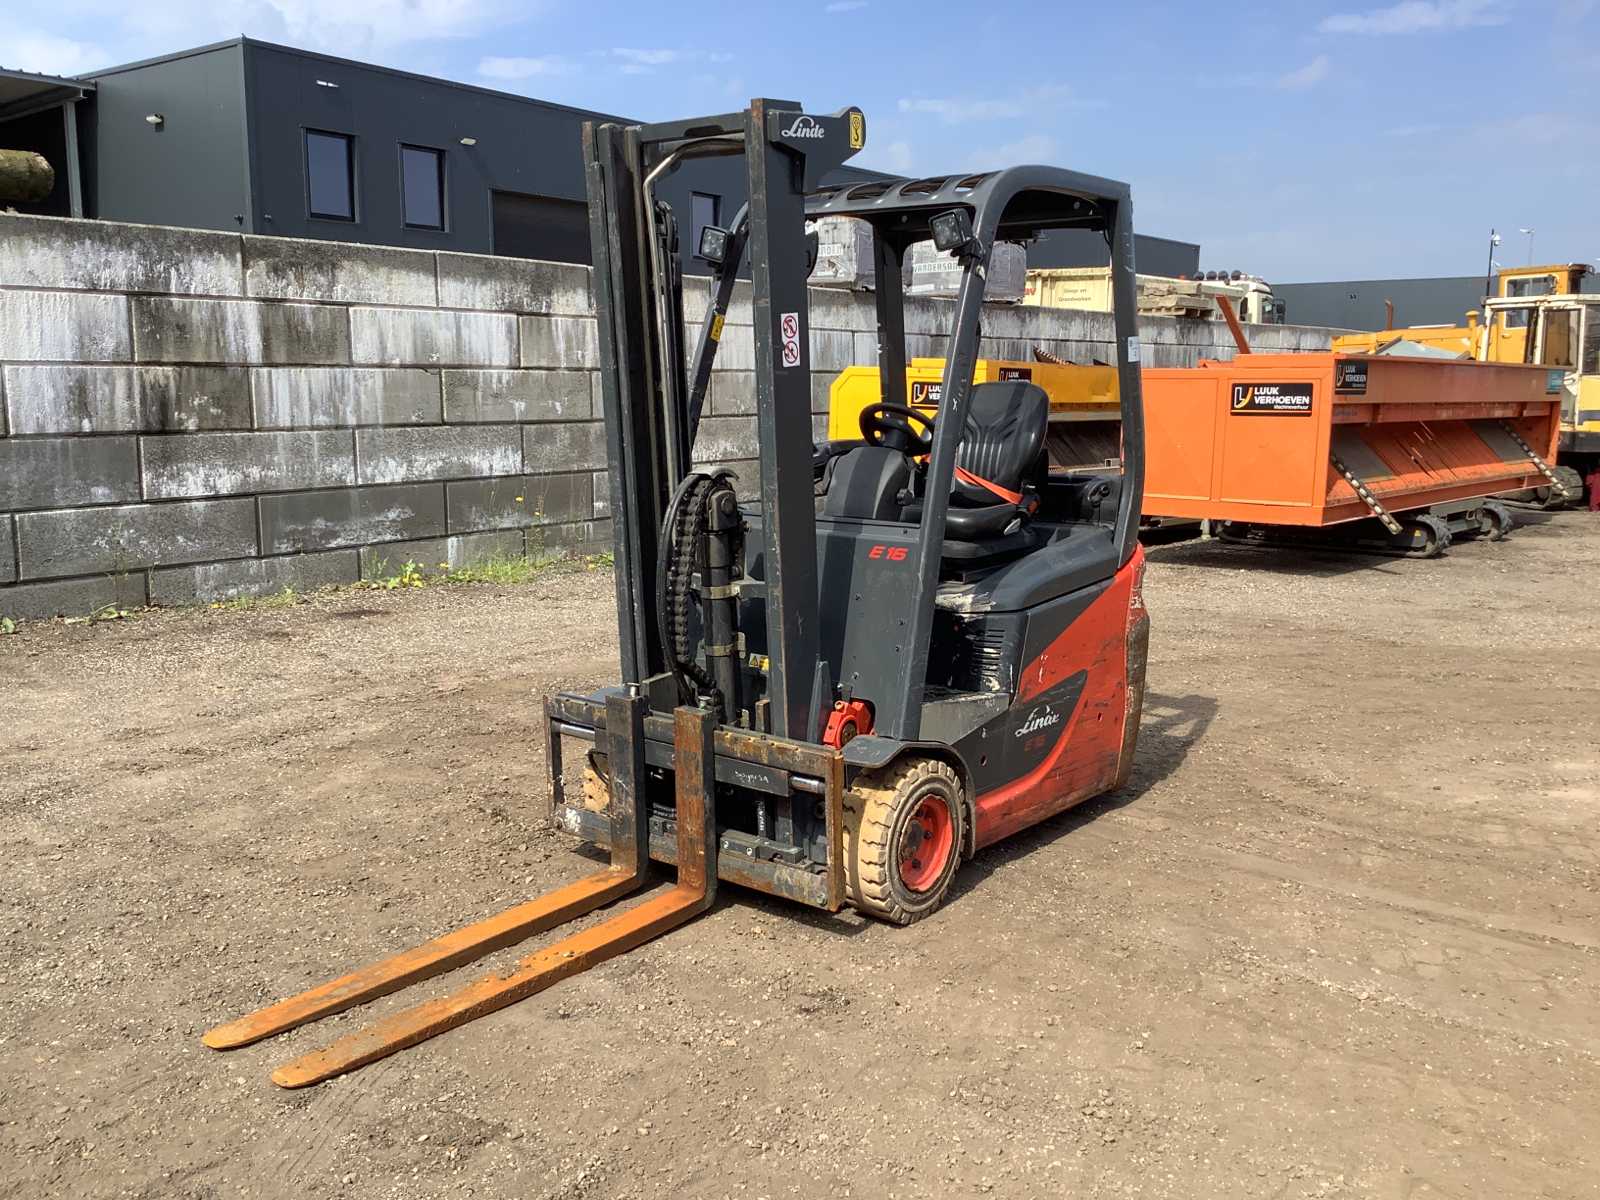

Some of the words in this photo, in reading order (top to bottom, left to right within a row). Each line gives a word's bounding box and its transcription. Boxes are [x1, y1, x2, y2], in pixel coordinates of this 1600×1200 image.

[781, 116, 825, 138] Linde
[928, 384, 941, 393] LUU
[1254, 386, 1279, 395] LUUK
[1254, 395, 1310, 405] VERHOEVEN
